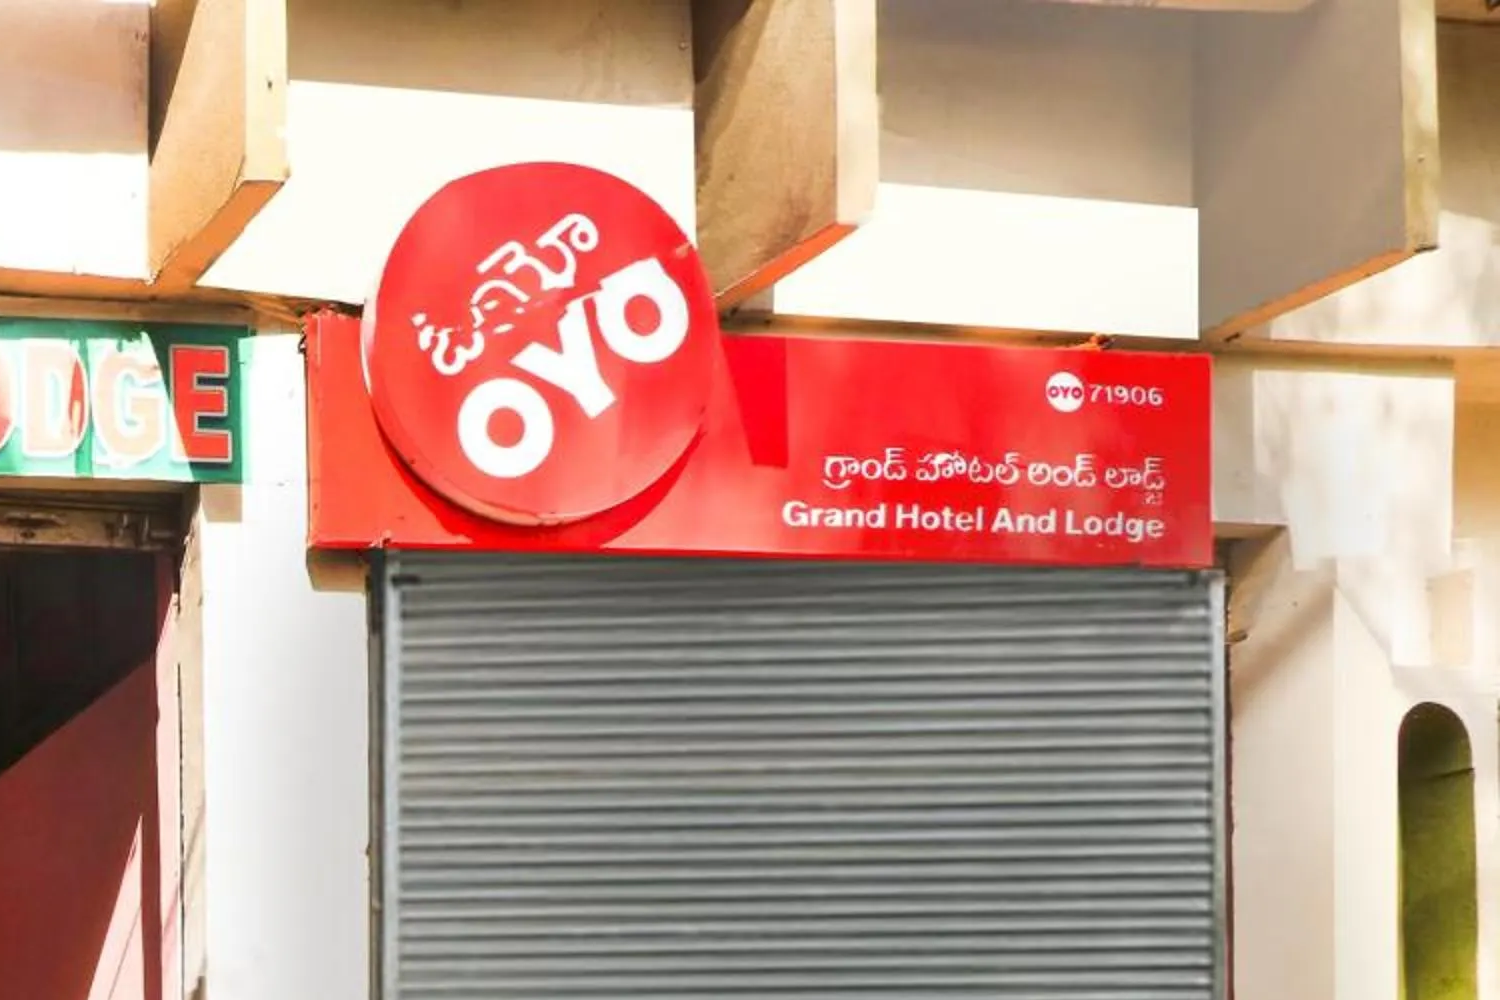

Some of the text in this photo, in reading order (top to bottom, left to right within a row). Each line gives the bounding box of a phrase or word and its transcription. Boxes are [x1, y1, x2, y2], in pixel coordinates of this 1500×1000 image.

[457, 257, 690, 478] OYO
[1049, 384, 1164, 406] OYO 71906
[822, 447, 907, 490] గ్రాండ్
[1027, 453, 1097, 487] అండ్
[782, 500, 1165, 543] Grand Hotel And Lodge
